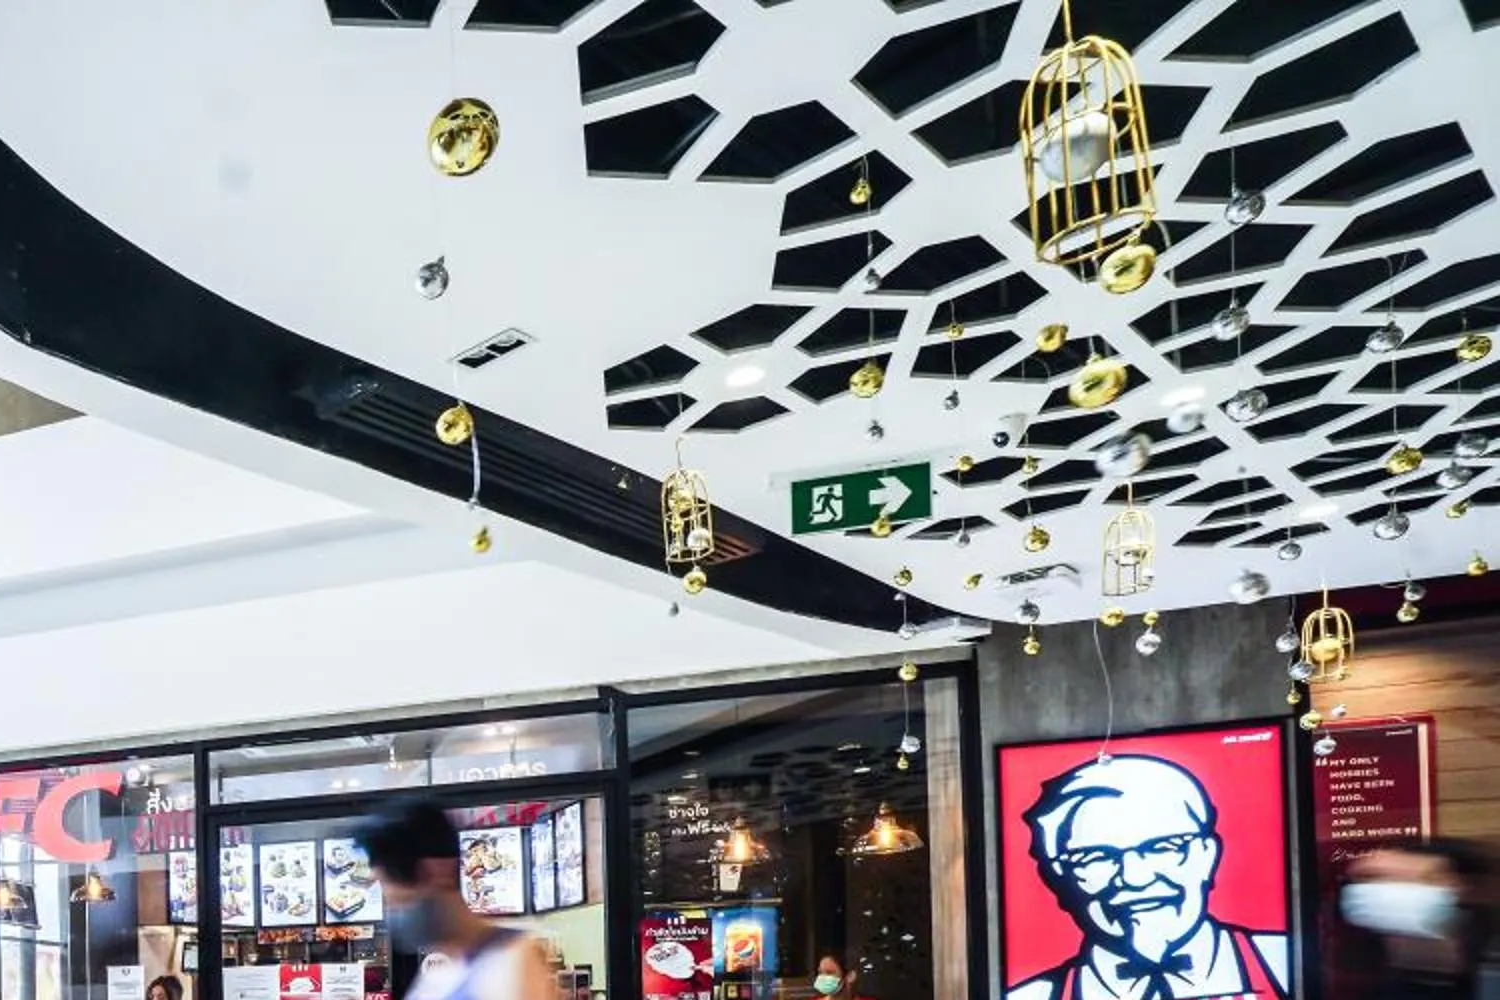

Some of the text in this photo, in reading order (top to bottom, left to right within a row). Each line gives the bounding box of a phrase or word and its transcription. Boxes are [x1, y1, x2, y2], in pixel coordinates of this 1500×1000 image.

[1349, 756, 1379, 765] ONLY
[1330, 781, 1361, 790] HAVE
[1331, 805, 1383, 815] COOKING
[1331, 818, 1357, 827] AND
[1331, 830, 1365, 839] HARD
